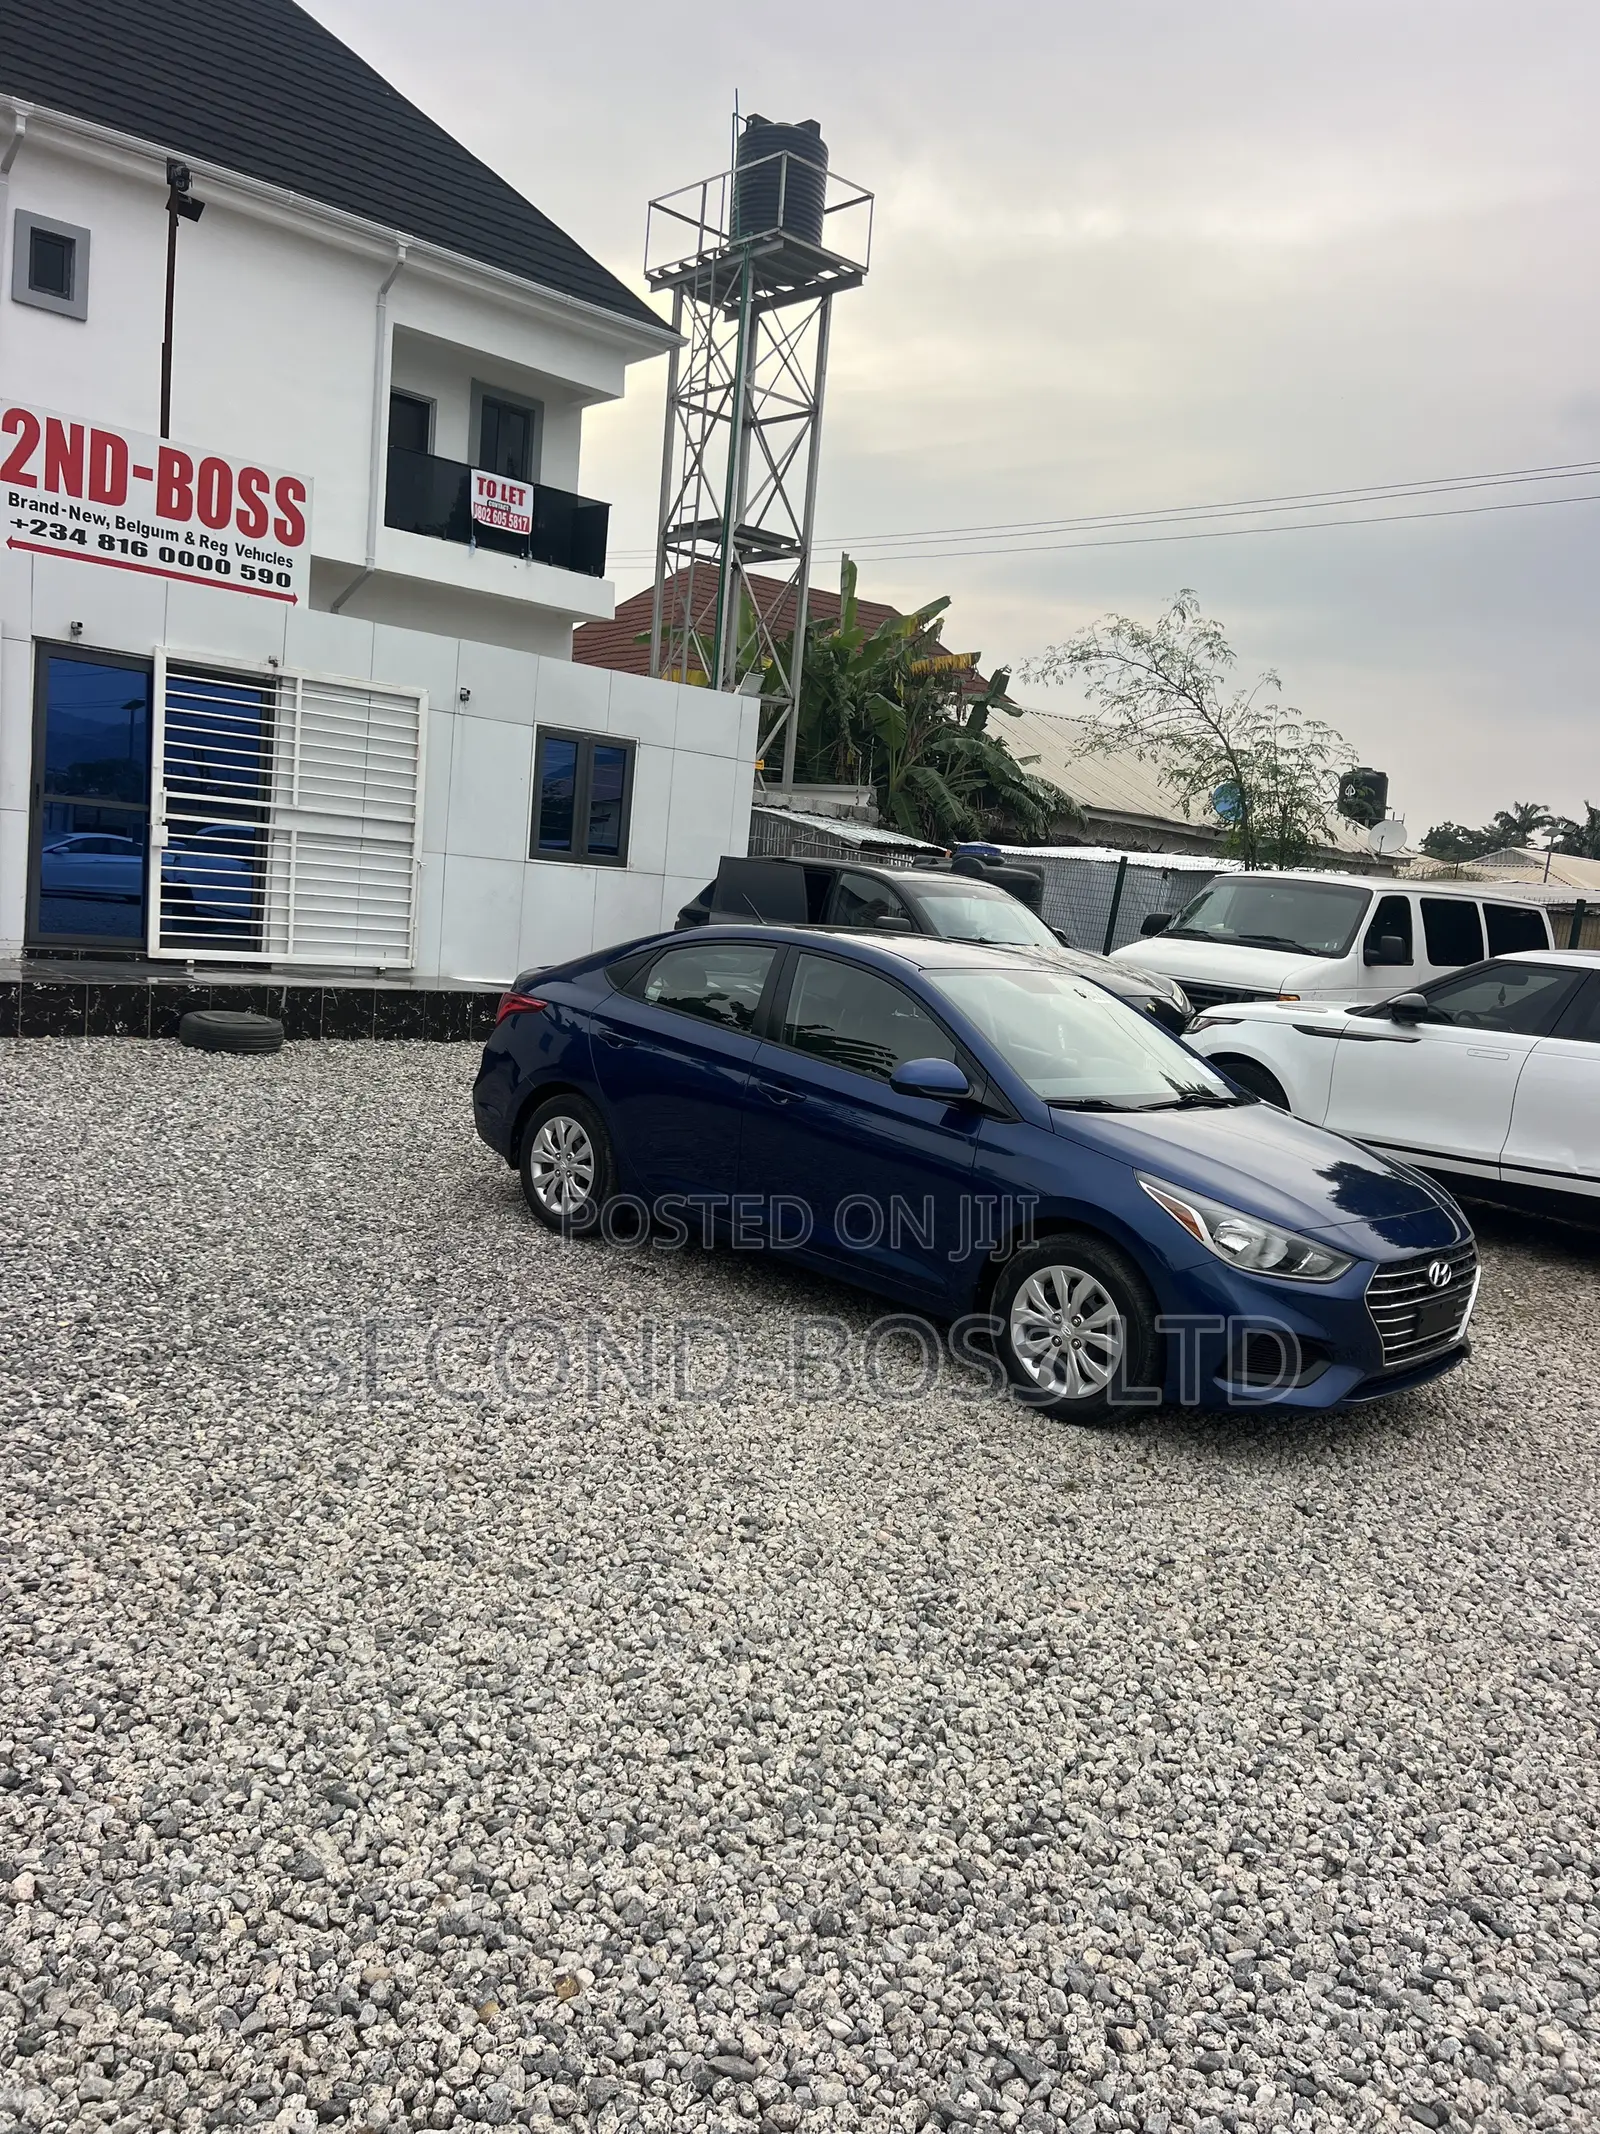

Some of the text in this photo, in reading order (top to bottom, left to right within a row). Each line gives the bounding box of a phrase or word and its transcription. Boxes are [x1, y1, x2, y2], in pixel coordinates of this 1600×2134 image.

[0, 407, 307, 548] 2ND-BOSS
[477, 477, 526, 506] TO LET
[8, 491, 111, 530] Brand-New,
[184, 531, 195, 546] &
[199, 534, 228, 557] Reg
[235, 542, 294, 569] Vehicles
[9, 518, 292, 588] +234 816 0000 590
[493, 510, 507, 526] 605
[509, 514, 528, 530] 5817
